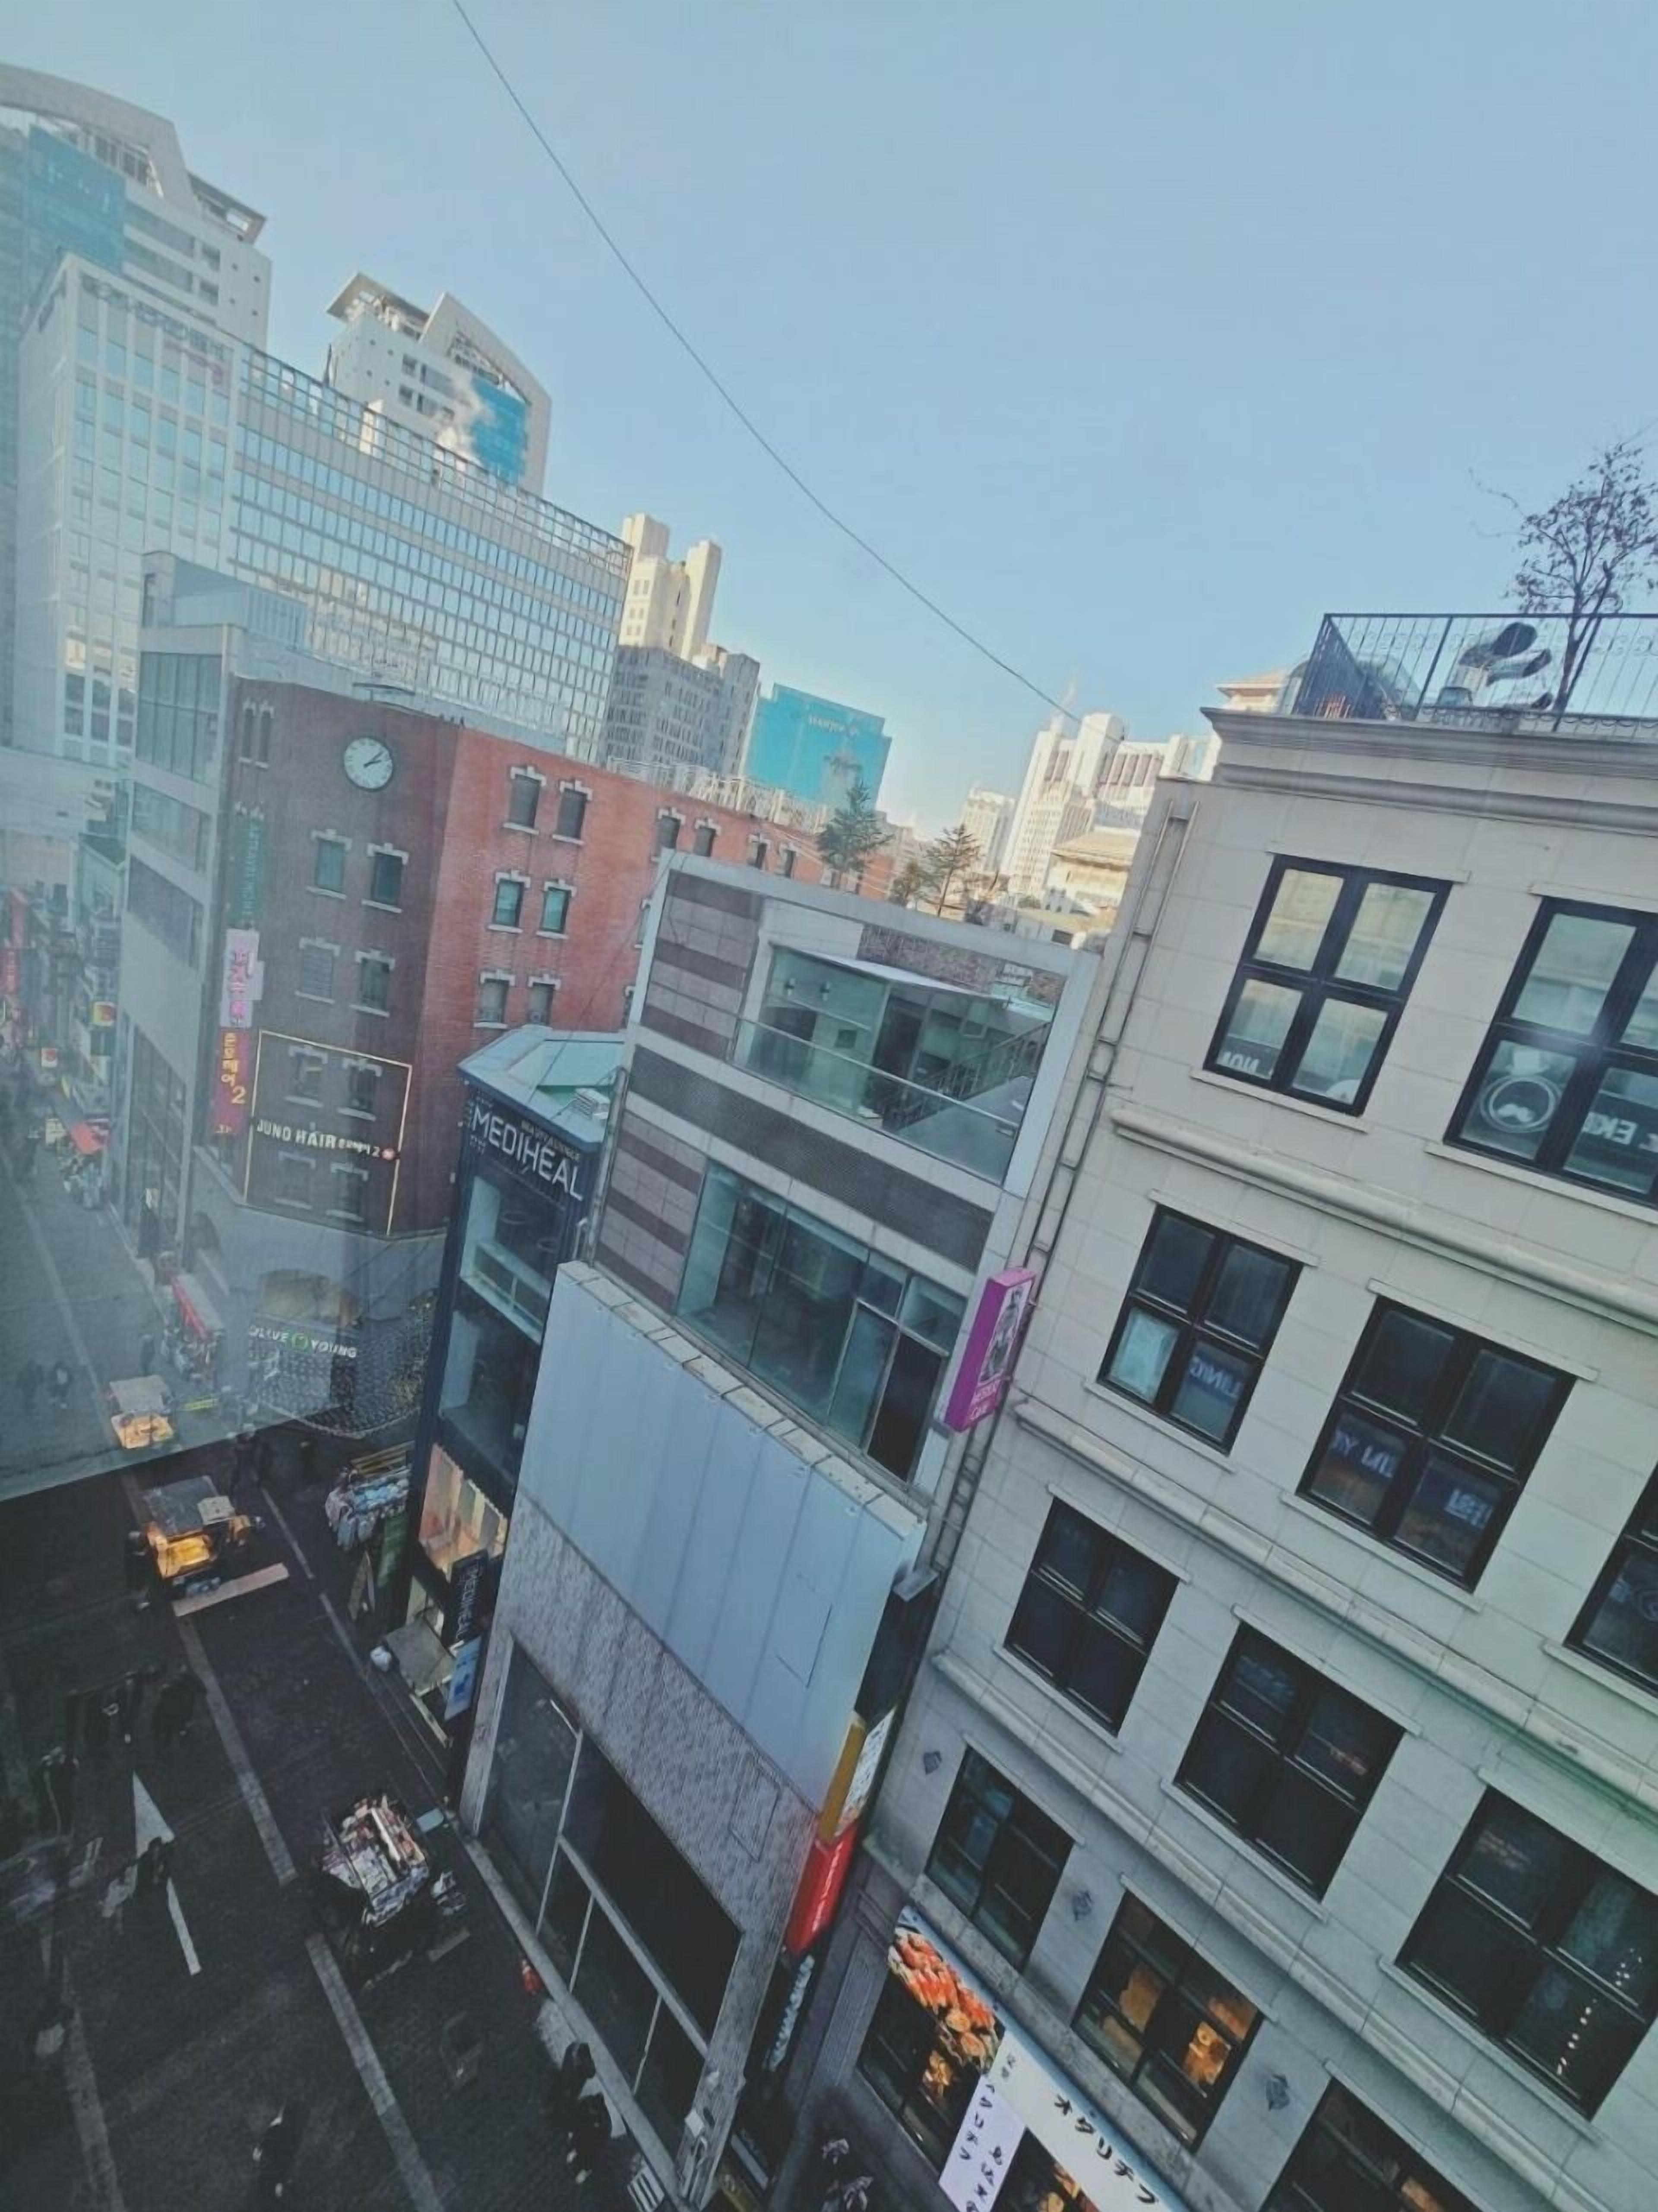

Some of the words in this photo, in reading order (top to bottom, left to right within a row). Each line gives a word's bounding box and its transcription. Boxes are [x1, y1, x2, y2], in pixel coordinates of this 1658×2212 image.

[257, 1119, 291, 1141] JUNO
[295, 1128, 336, 1149] HAIR
[472, 1105, 584, 1202] MEDIHEAL
[248, 1324, 290, 1343] OLIVE
[311, 1339, 357, 1359] YOUNG
